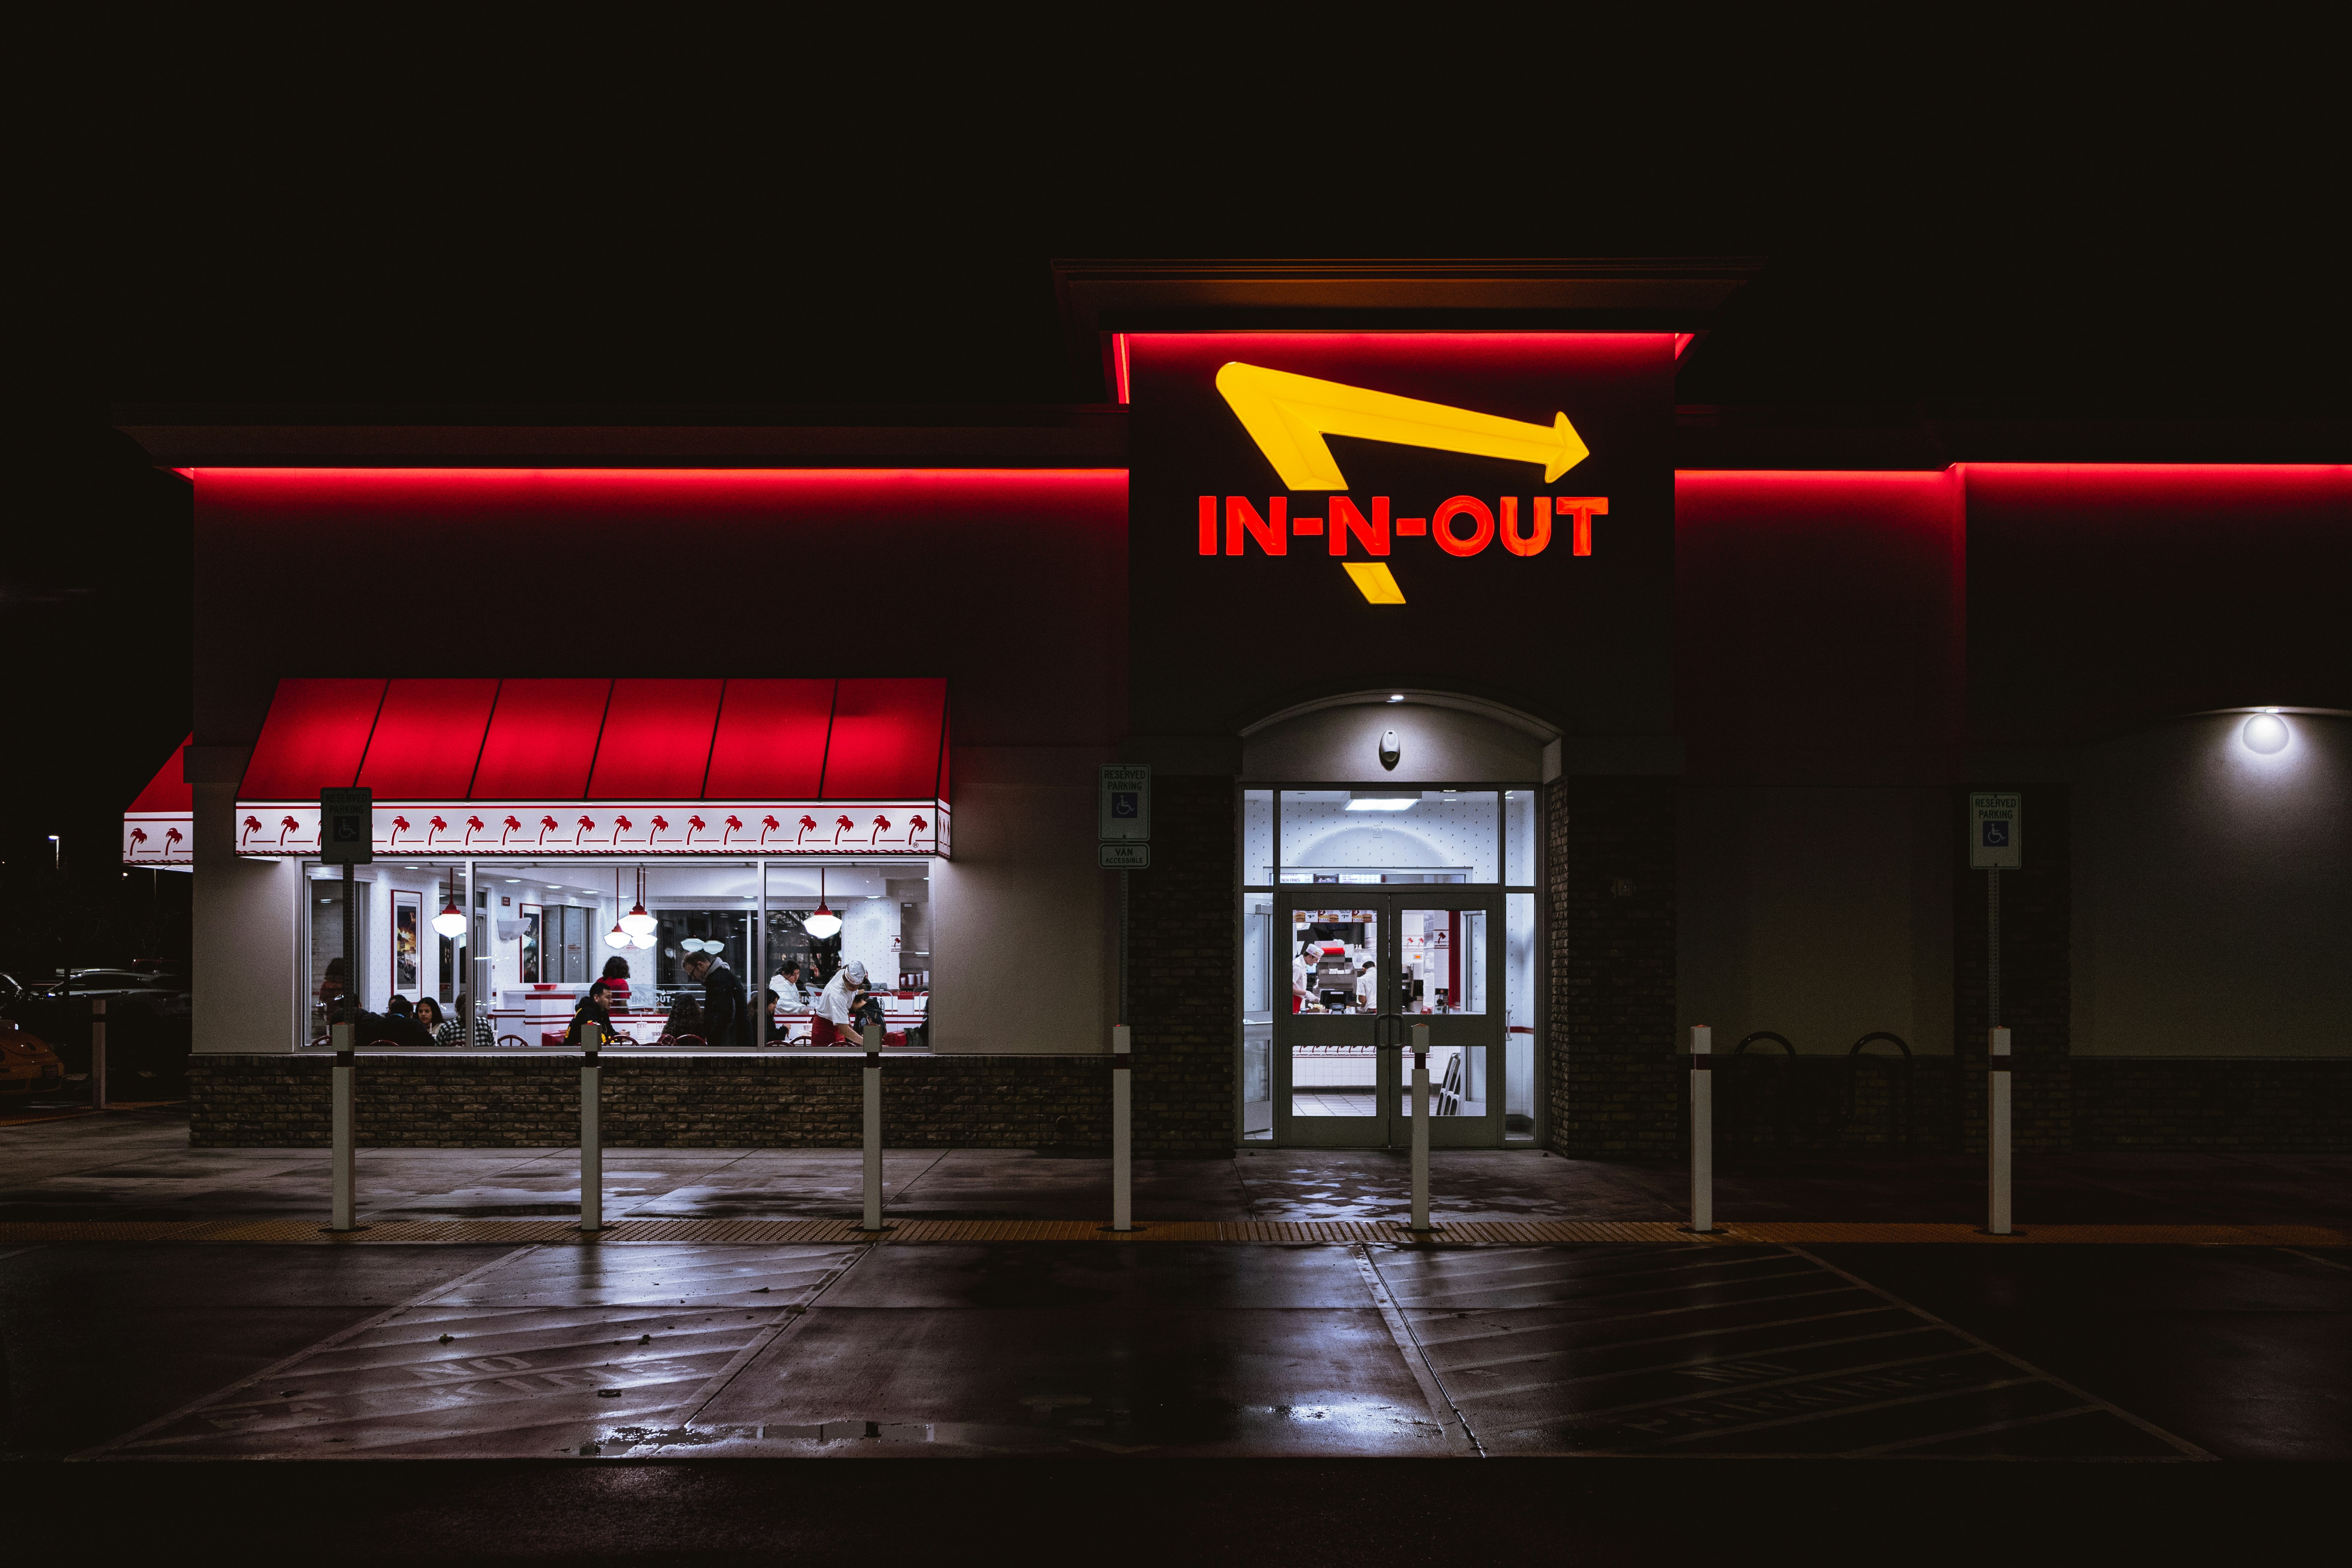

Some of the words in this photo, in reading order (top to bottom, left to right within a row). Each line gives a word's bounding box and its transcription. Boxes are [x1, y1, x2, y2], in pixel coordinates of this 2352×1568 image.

[1199, 495, 1609, 557] IN-N-OUT
[1104, 770, 1145, 779] RESERVED
[1108, 781, 1142, 790] PARKING
[326, 794, 367, 803] RESERVED
[1975, 798, 2016, 808] RESERVED
[329, 805, 364, 814] PARKING
[1979, 810, 2013, 819] PARKING
[400, 1356, 532, 1381] NO
[1671, 1361, 1800, 1384] NO
